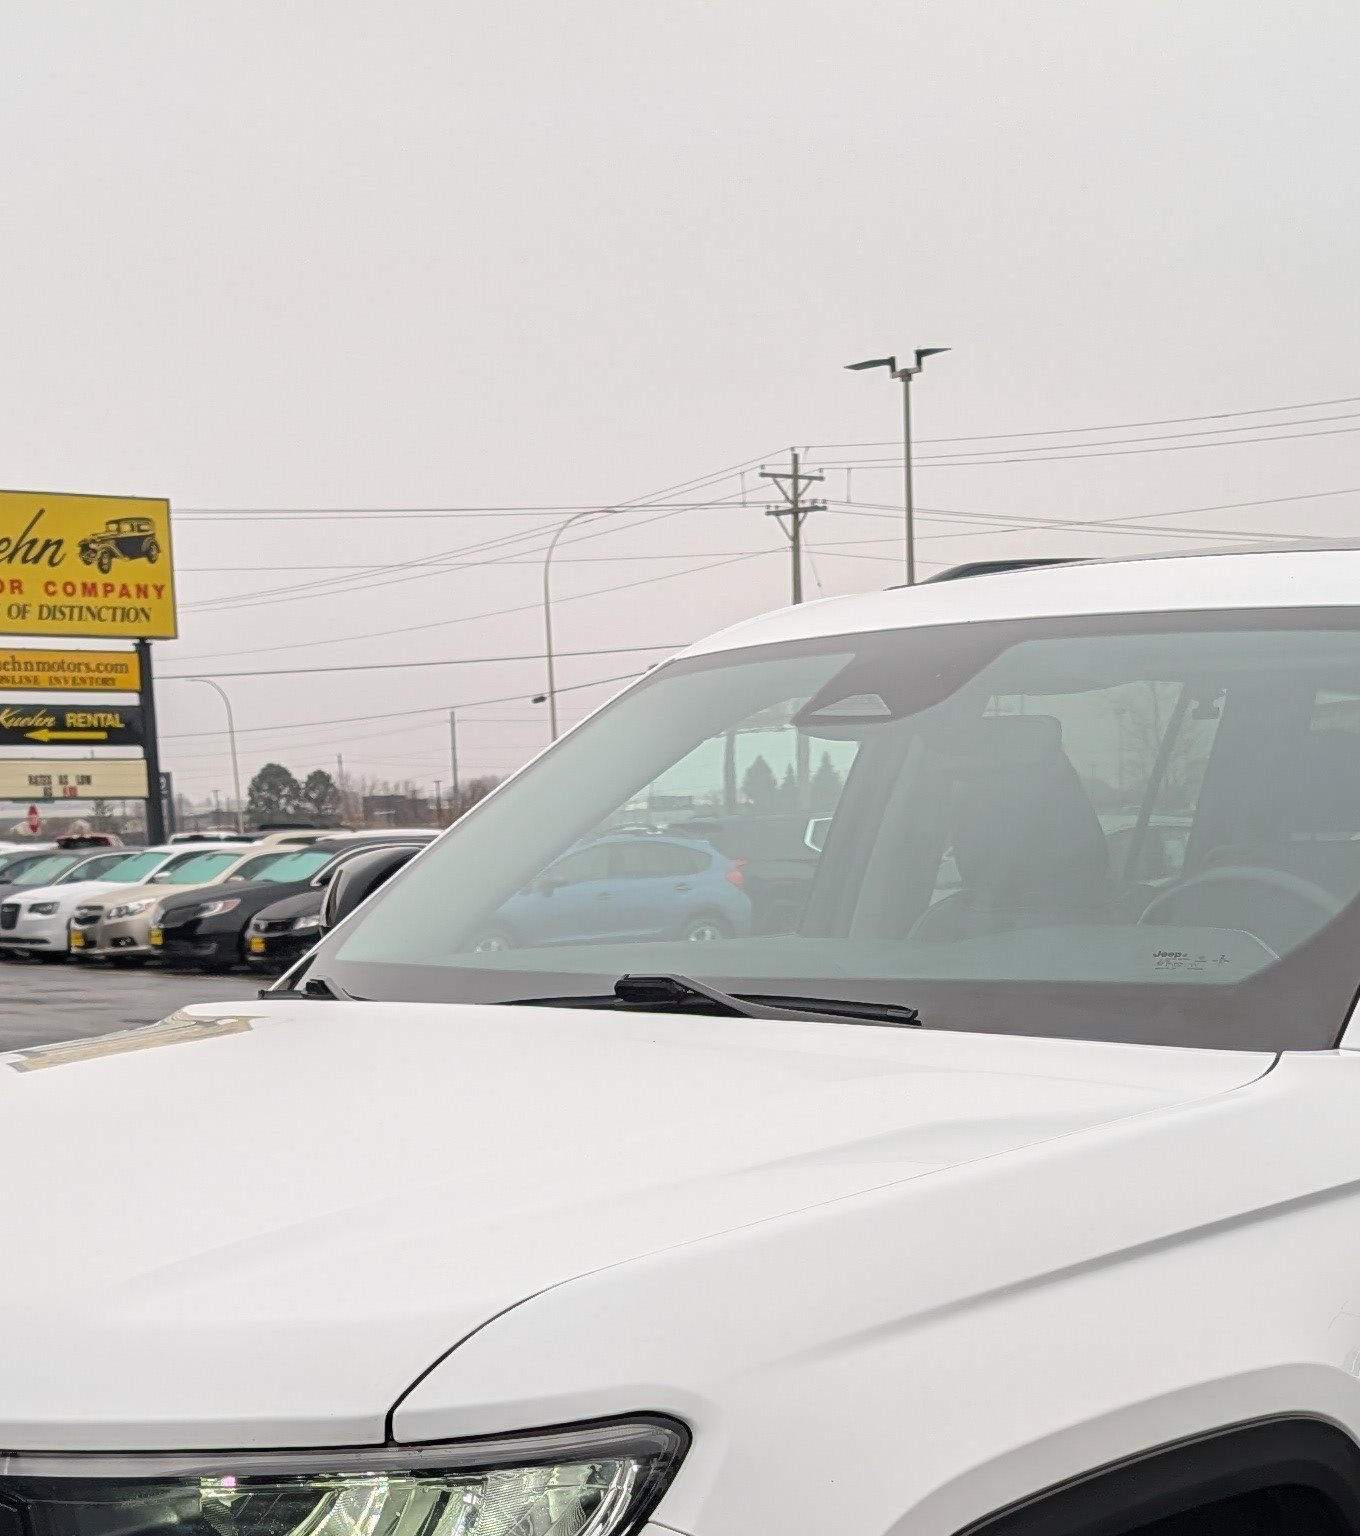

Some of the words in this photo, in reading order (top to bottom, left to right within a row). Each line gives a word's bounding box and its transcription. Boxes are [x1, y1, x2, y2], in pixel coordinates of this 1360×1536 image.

[43, 581, 166, 600] COMPANY
[7, 602, 32, 621] OF
[38, 604, 153, 623] DISTINCTION
[48, 676, 117, 687] INVENTORY
[65, 712, 125, 729] RENTAL
